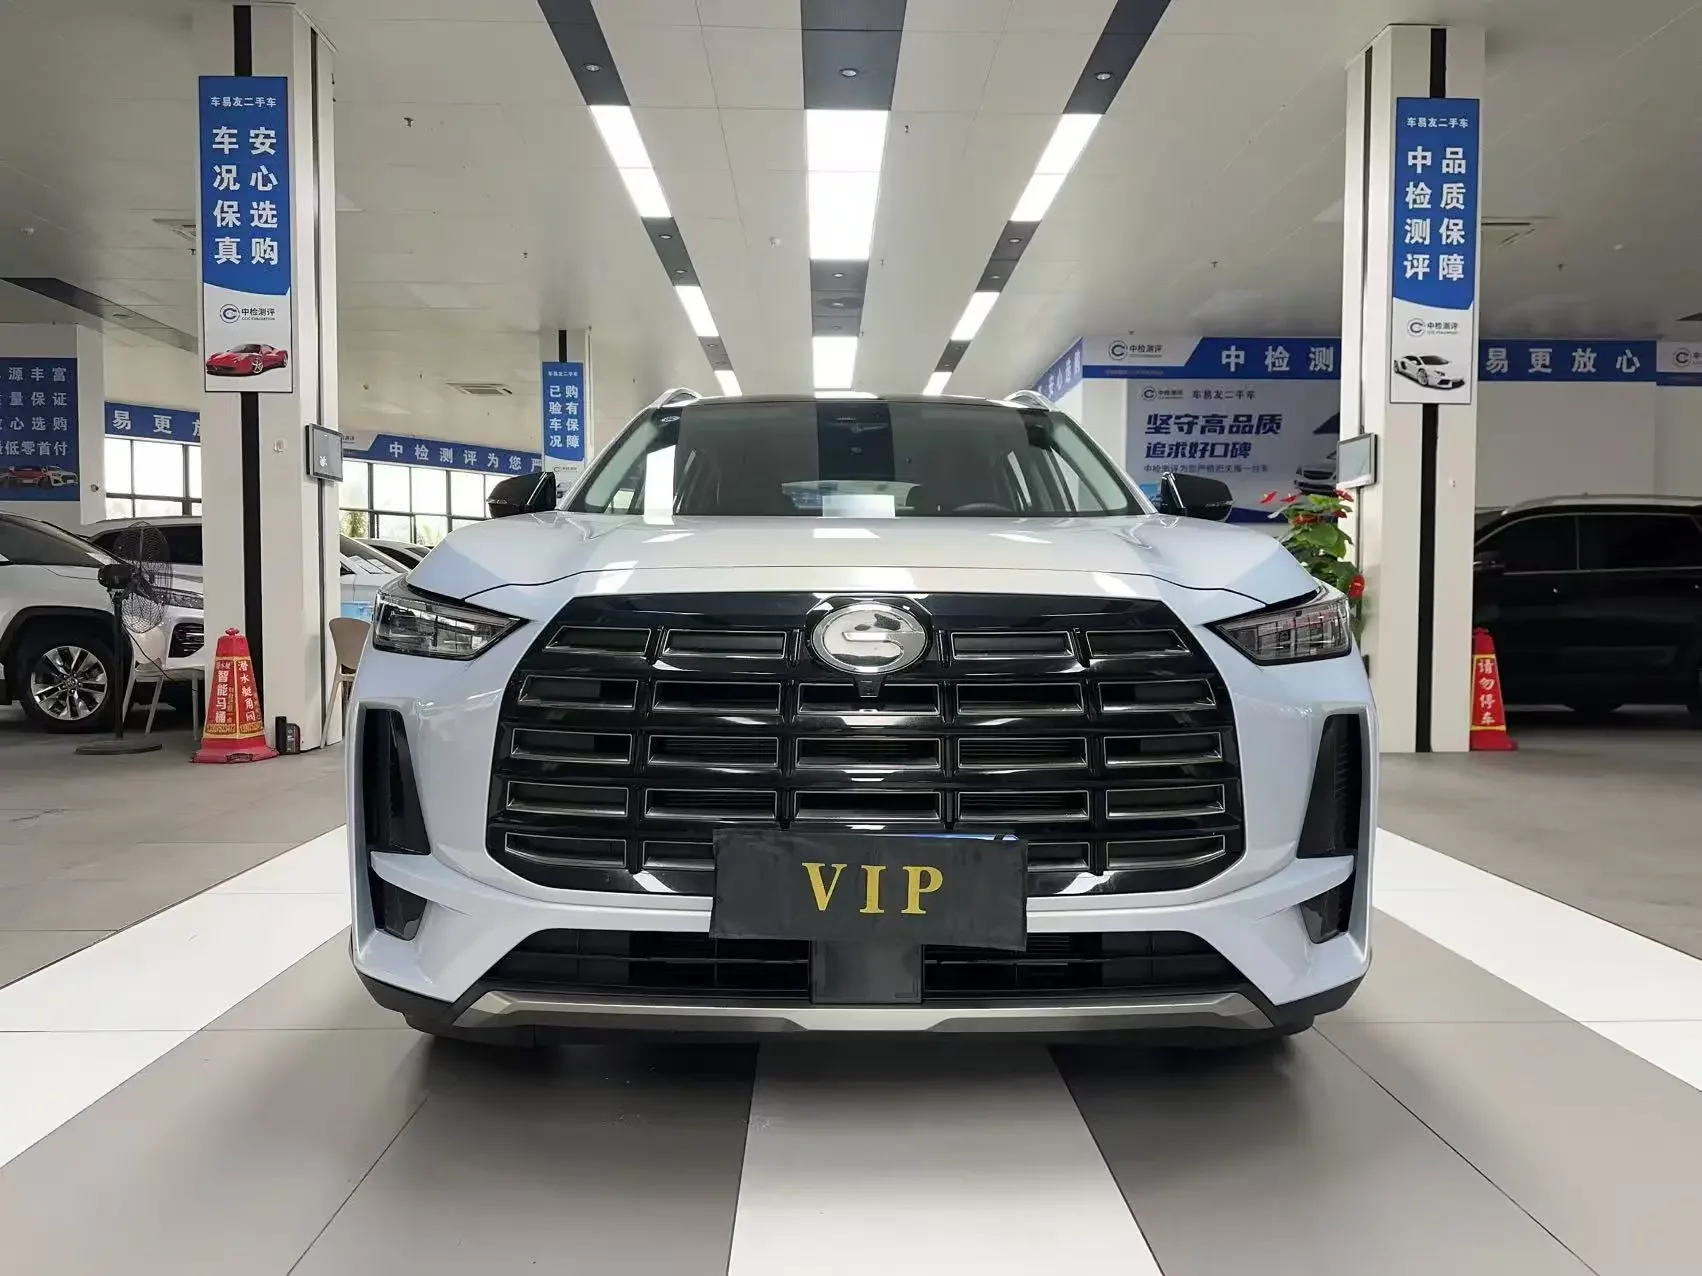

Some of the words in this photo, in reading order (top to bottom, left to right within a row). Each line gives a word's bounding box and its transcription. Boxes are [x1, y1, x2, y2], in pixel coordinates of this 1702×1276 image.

[210, 96, 277, 108] 车易友二手车
[1406, 117, 1469, 129] 车易友二手车
[212, 126, 242, 264] 车况保真
[249, 126, 279, 265] 安心选购
[1403, 145, 1432, 281] 中检测评
[1438, 147, 1466, 282] 品质保障
[241, 307, 276, 316] 中检测评
[1221, 345, 1334, 373] 中检测
[1486, 347, 1641, 374] 易更放心
[0, 366, 67, 382] 源丰富
[0, 391, 67, 406] 量保证
[0, 416, 68, 431] 心选购
[549, 385, 562, 448] 已验车况
[565, 385, 580, 448] 购有保障
[1145, 413, 1283, 435] 坚守高品质
[1145, 441, 1253, 459] 追求好口碑
[215, 670, 229, 723] 智能马桶
[1477, 659, 1496, 725] 请勿停车
[801, 862, 944, 914] VIP
